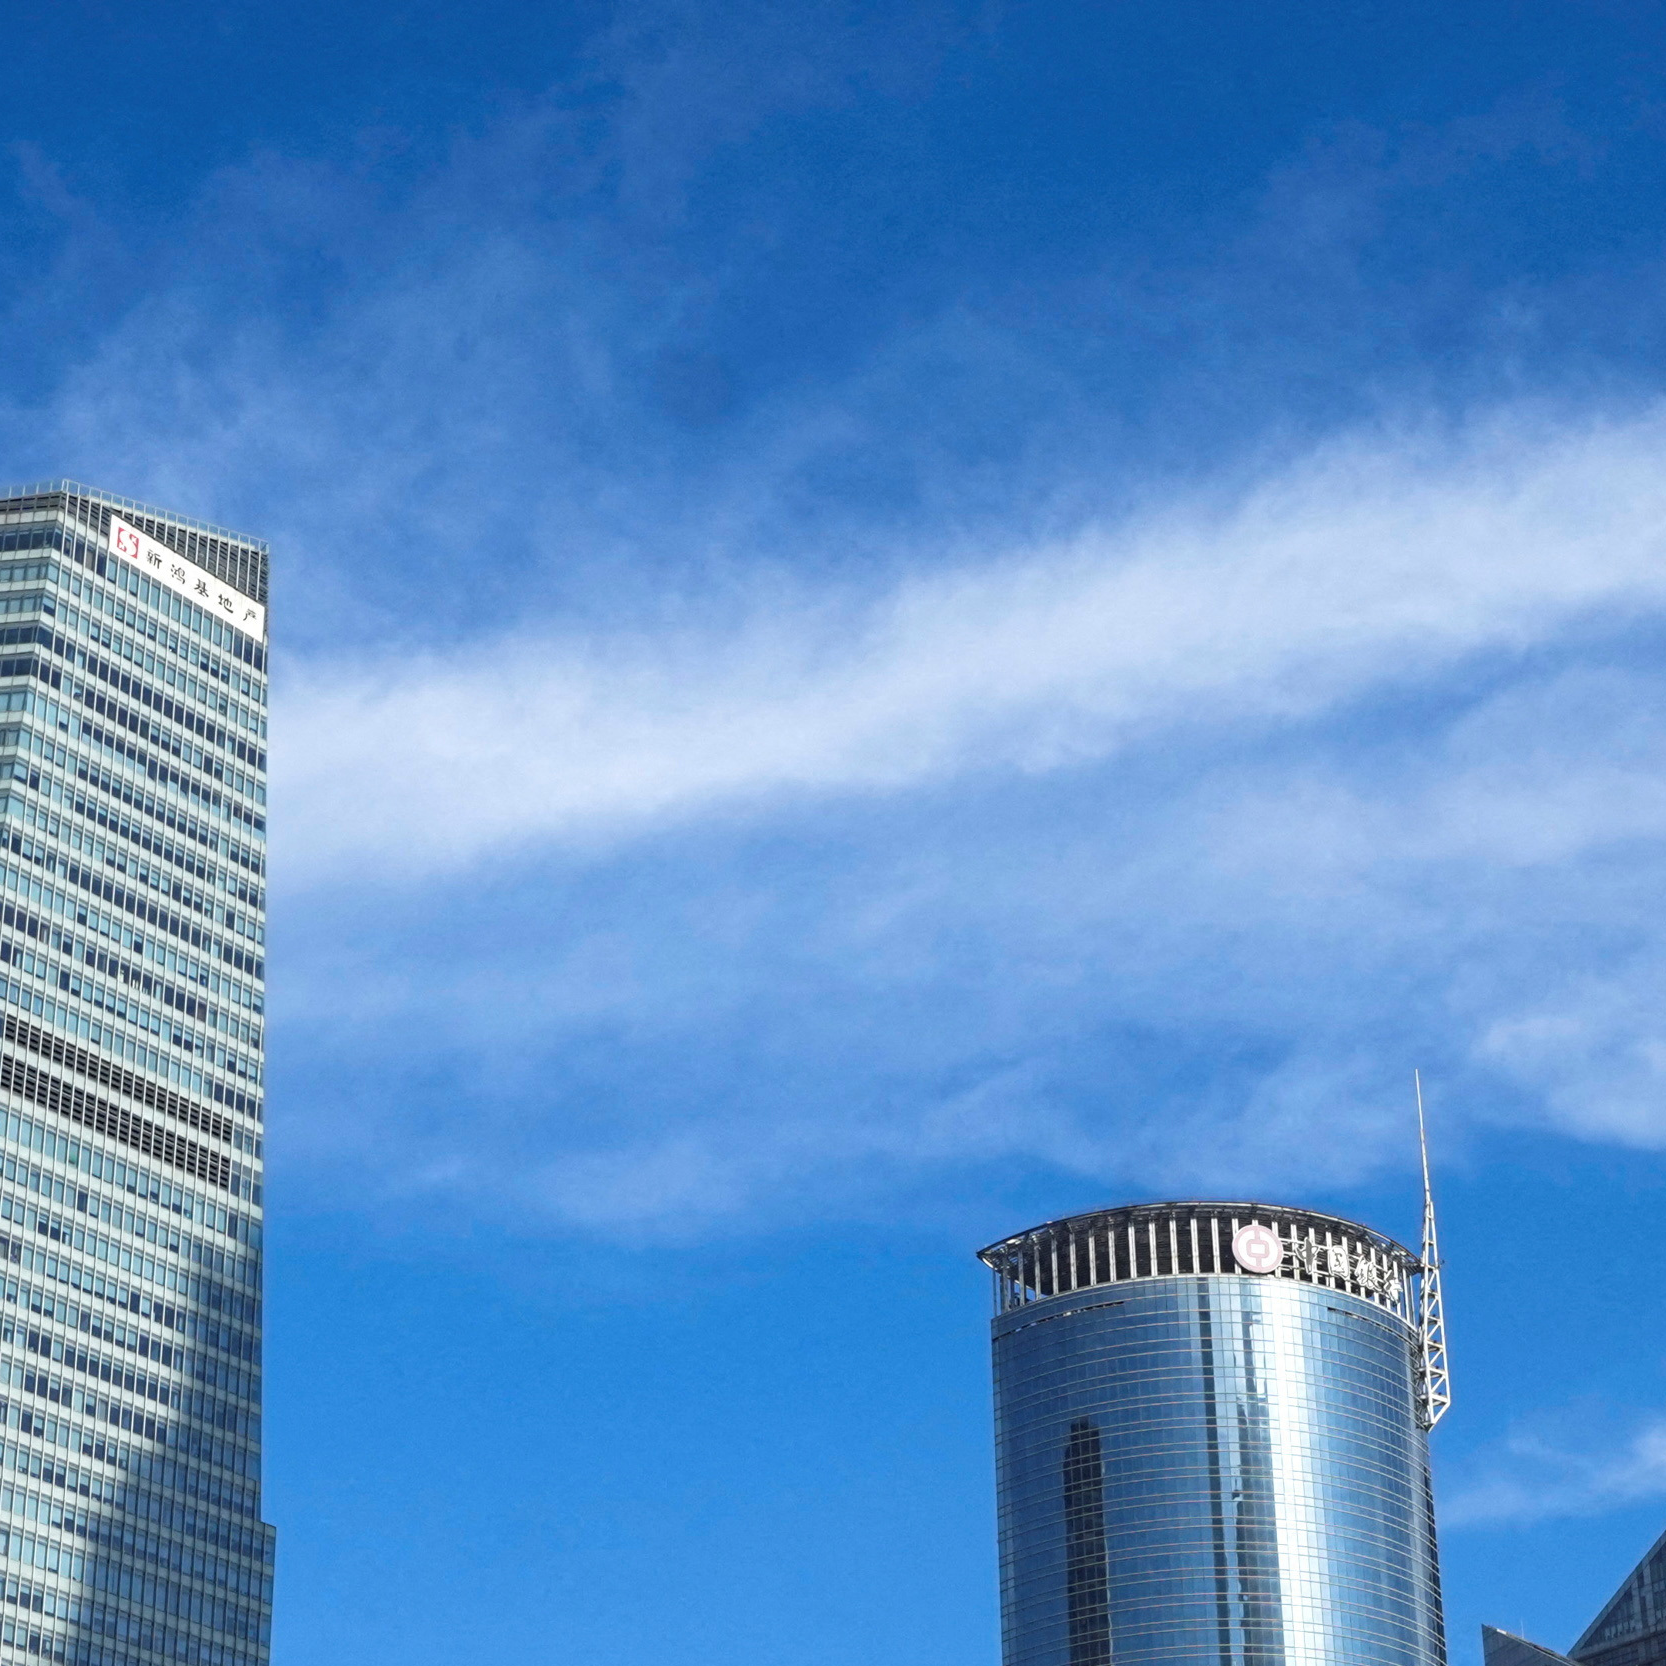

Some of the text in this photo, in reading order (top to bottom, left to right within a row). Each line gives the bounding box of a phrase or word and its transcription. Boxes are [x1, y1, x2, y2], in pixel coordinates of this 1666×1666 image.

[146, 548, 257, 622] 新鸿基地产
